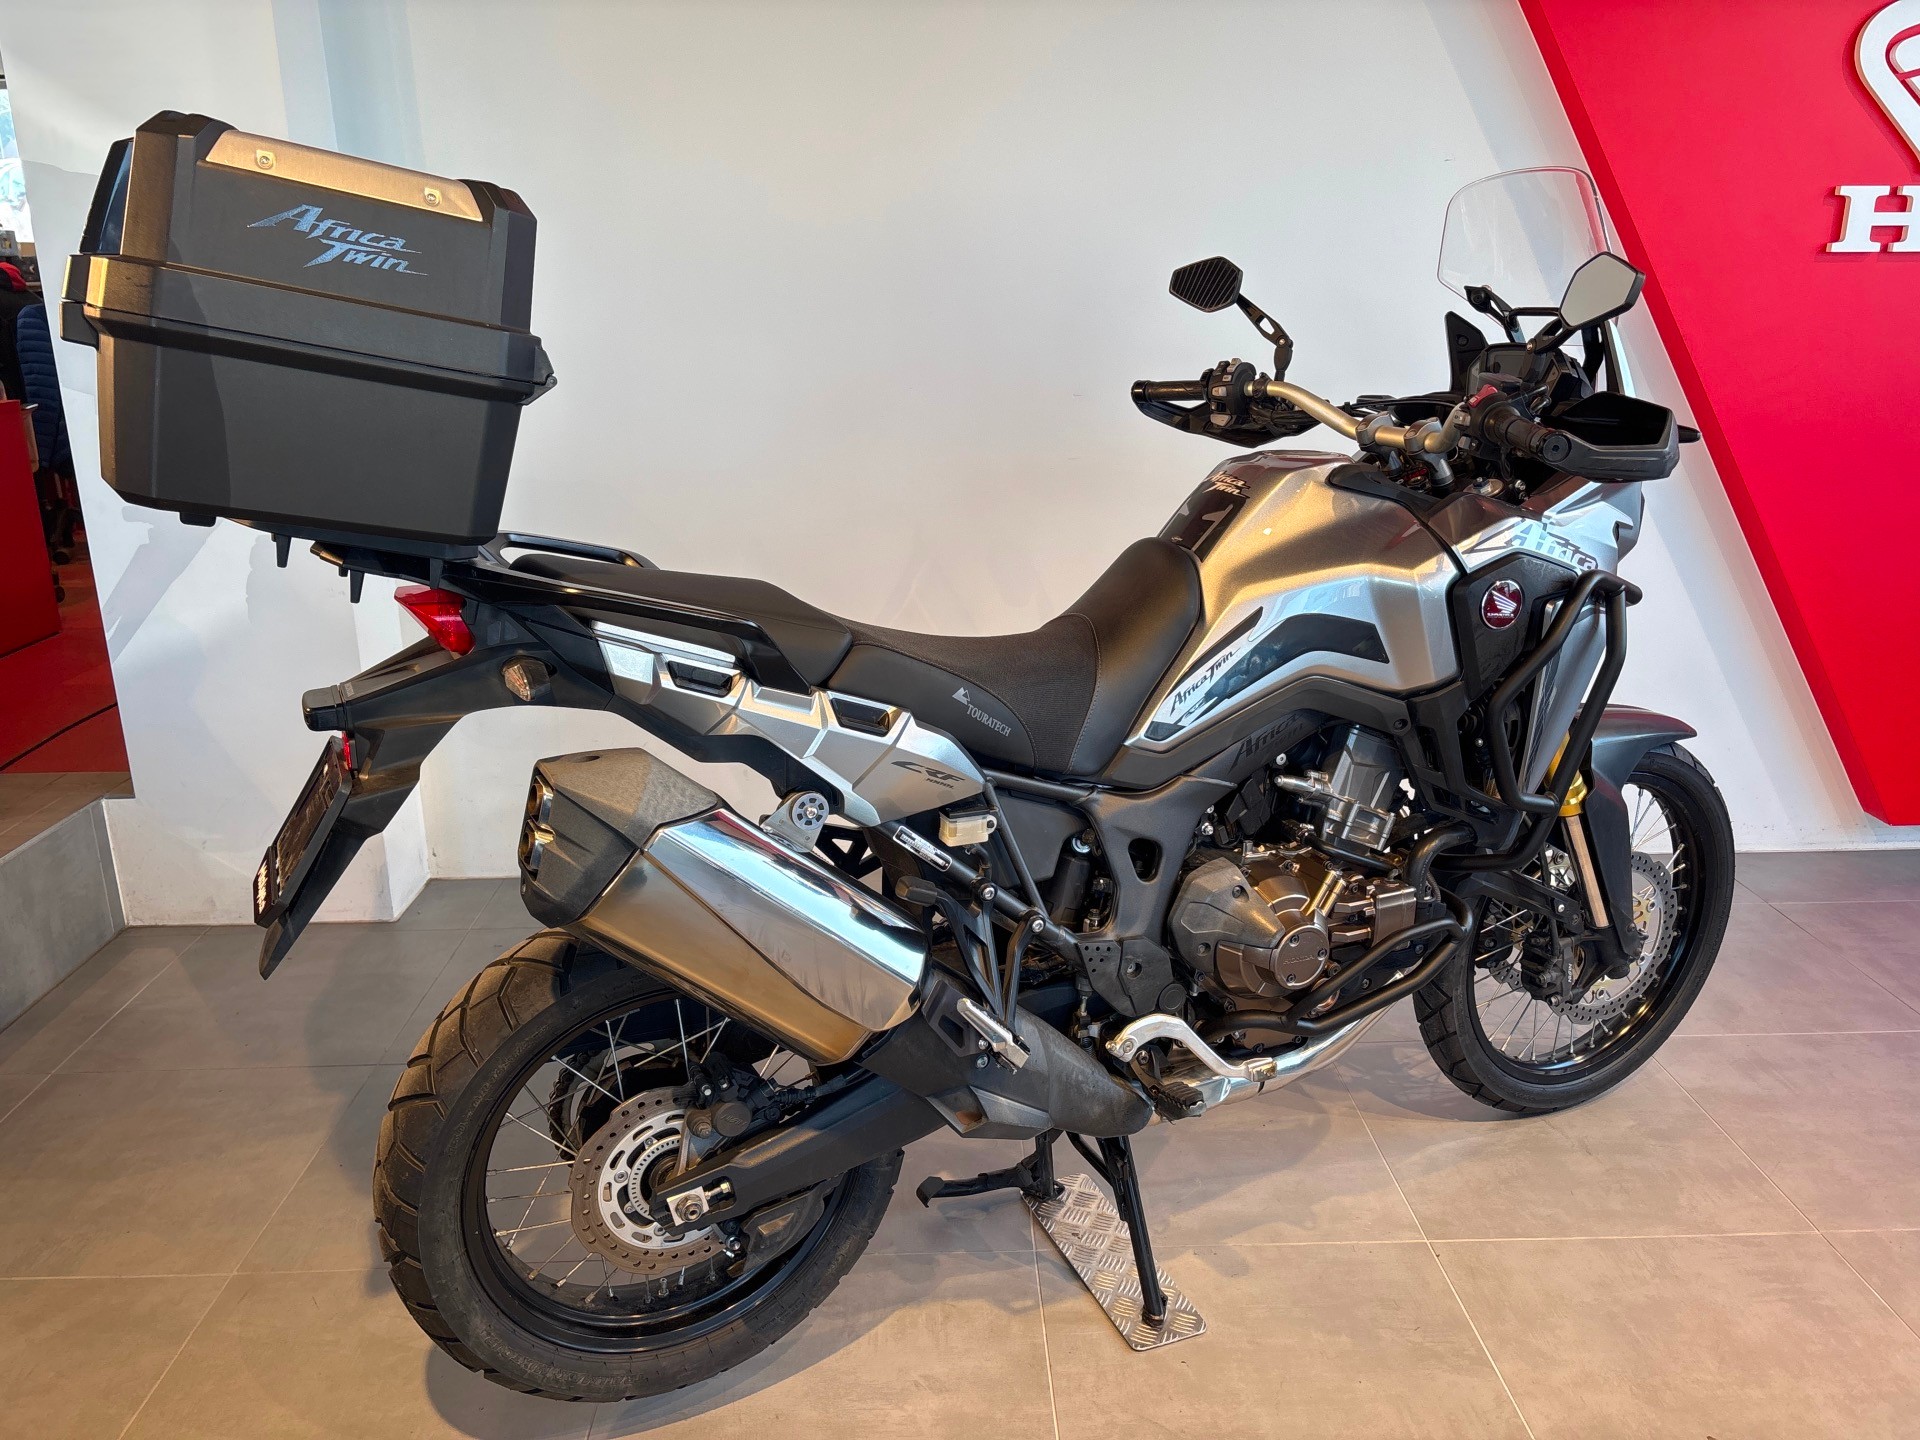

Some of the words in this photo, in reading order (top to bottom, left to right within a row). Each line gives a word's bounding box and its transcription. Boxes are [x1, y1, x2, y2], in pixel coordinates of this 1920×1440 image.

[247, 204, 422, 254] Africa
[303, 238, 428, 276] Twin
[1462, 518, 1599, 571] Africa
[1170, 674, 1212, 717] Africa
[1205, 647, 1241, 684] Twin
[966, 703, 1012, 737] TOURATECH
[890, 761, 966, 782] CRF
